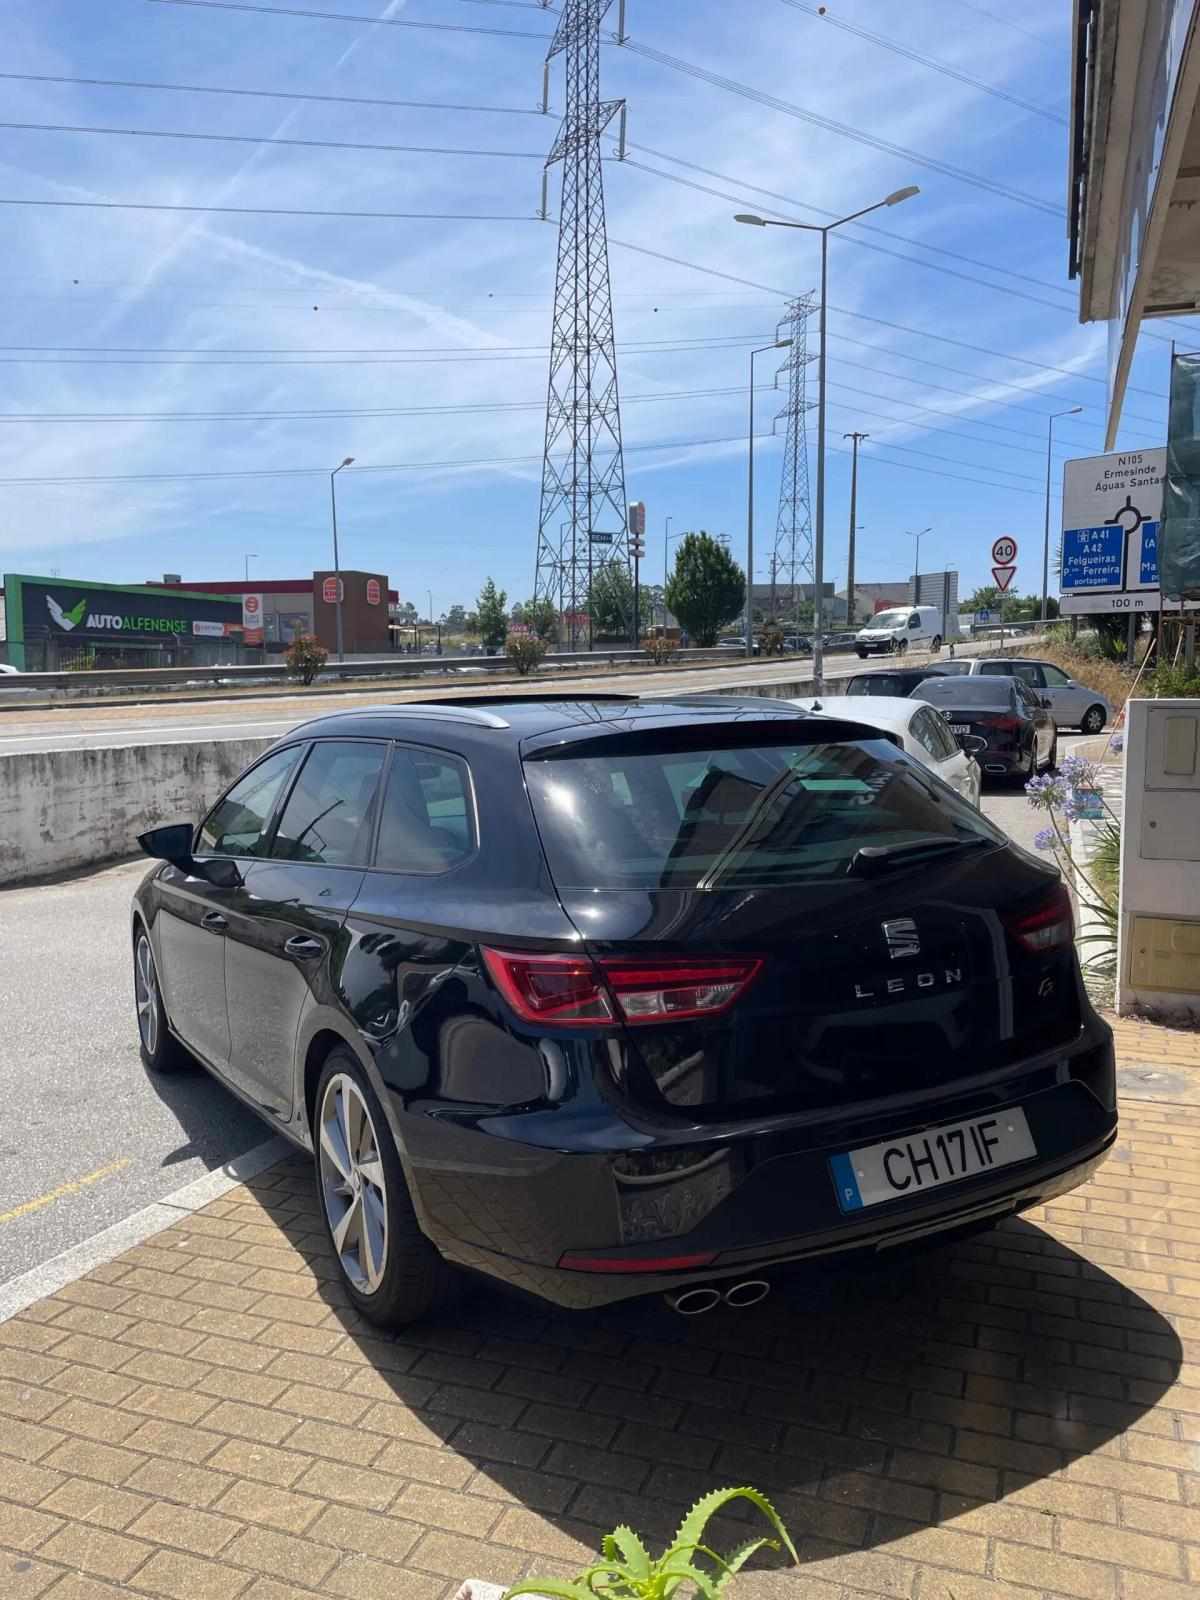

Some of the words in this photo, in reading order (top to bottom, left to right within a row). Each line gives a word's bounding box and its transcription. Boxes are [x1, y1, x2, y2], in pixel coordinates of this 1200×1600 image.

[1118, 454, 1144, 466] N105
[1104, 465, 1157, 479] Ermesinde
[995, 544, 1013, 557] 40
[1067, 555, 1117, 567] Felgueiras
[1083, 564, 1121, 576] Ferreira
[1074, 577, 1109, 586] portagem
[1111, 598, 1131, 609] 100
[1134, 599, 1145, 608] m
[854, 968, 962, 999] LEON
